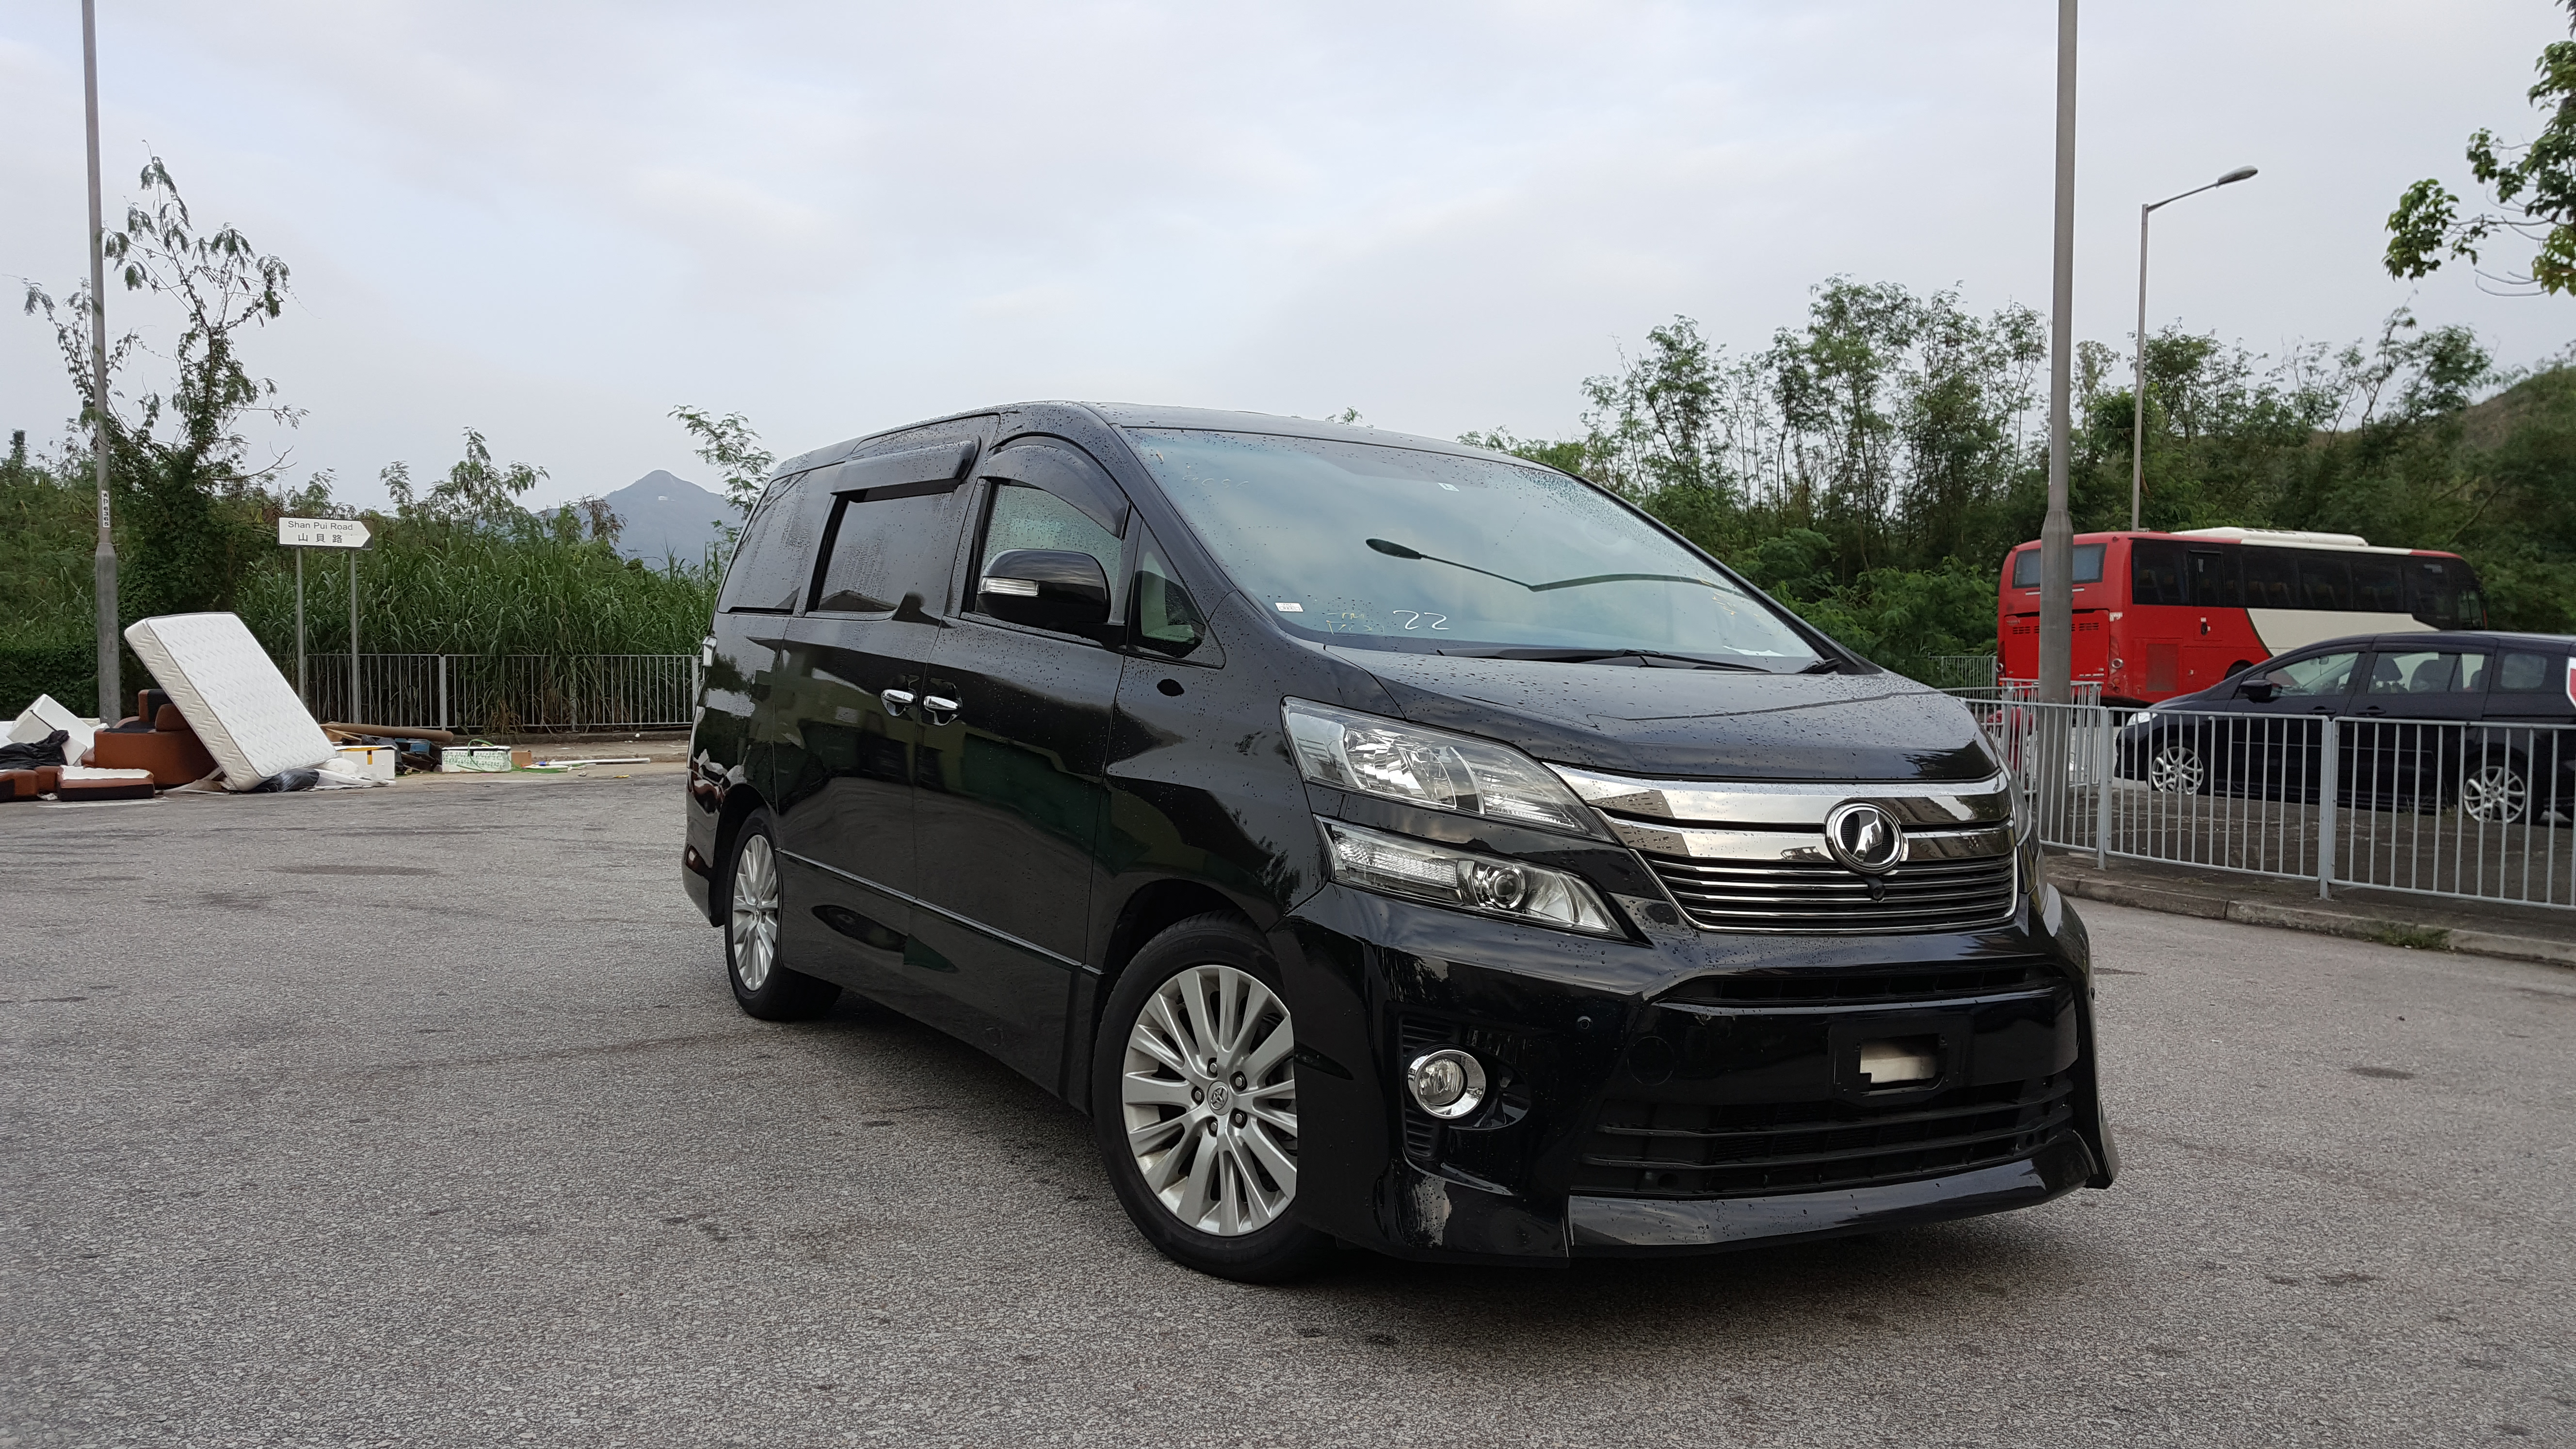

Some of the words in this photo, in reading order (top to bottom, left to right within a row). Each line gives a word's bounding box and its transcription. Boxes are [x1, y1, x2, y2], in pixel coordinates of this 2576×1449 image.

[288, 520, 310, 529] Shan
[298, 532, 343, 544] 山貝路
[1393, 610, 1450, 630] 22
